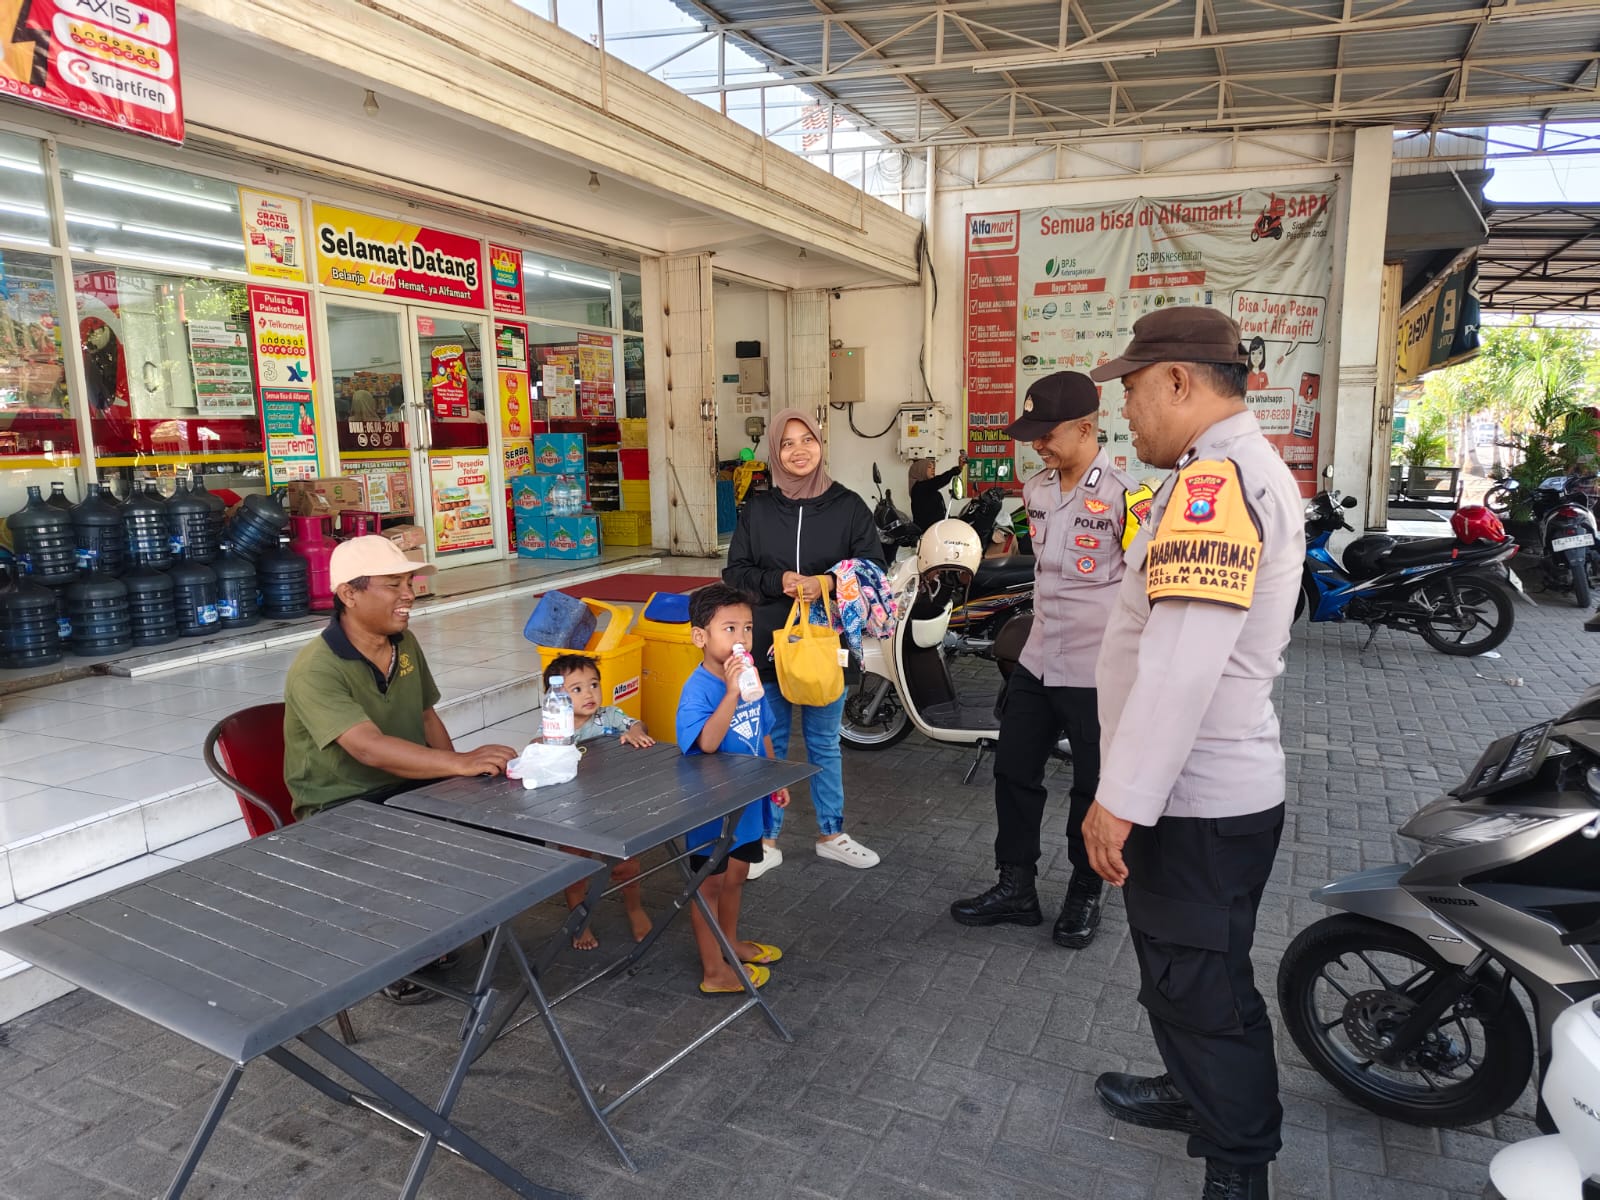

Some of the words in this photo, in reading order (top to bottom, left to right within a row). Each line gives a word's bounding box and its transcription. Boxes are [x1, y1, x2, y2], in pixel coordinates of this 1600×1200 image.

[76, 0, 131, 25] AXIS
[73, 26, 157, 60] indosat
[91, 70, 166, 105] smartfren
[1288, 194, 1328, 218] SAPA
[257, 211, 288, 223] GRATIS
[1040, 215, 1095, 236] Semua
[1100, 210, 1134, 231] bisa
[1139, 206, 1153, 226] di
[971, 218, 1014, 235] Alfamart
[320, 227, 410, 266] Selamat
[411, 246, 477, 287] Datang
[1061, 258, 1076, 268] BPJS
[332, 267, 366, 285] Belanja
[368, 271, 396, 289] Lebih
[398, 280, 427, 293] Hemat,
[428, 286, 438, 296] ya
[438, 285, 472, 299] Alfamart
[264, 294, 286, 305] Pulsa
[1238, 296, 1259, 313] Bisa
[1262, 298, 1286, 318] Juga
[1289, 299, 1319, 317] Pesan
[260, 304, 281, 313] Paket
[282, 306, 299, 315] Data
[268, 320, 305, 331] Telkomsel
[1240, 316, 1269, 334] Lewat
[1270, 318, 1314, 339] Alfagift!
[262, 336, 305, 346] indosat
[260, 345, 306, 356] ooredoo
[1256, 395, 1283, 406] Whatsapp
[505, 446, 529, 460] SERBA
[456, 459, 484, 468] Tersedia
[505, 455, 530, 469] GRATIS
[1074, 517, 1109, 531] POLRI
[1150, 539, 1256, 573] BHABINKAMTIBMAS
[1178, 566, 1248, 582] MANGGE
[1199, 576, 1248, 591] BARAT
[614, 677, 639, 696] Alfamart
[1428, 896, 1479, 907] HONDA
